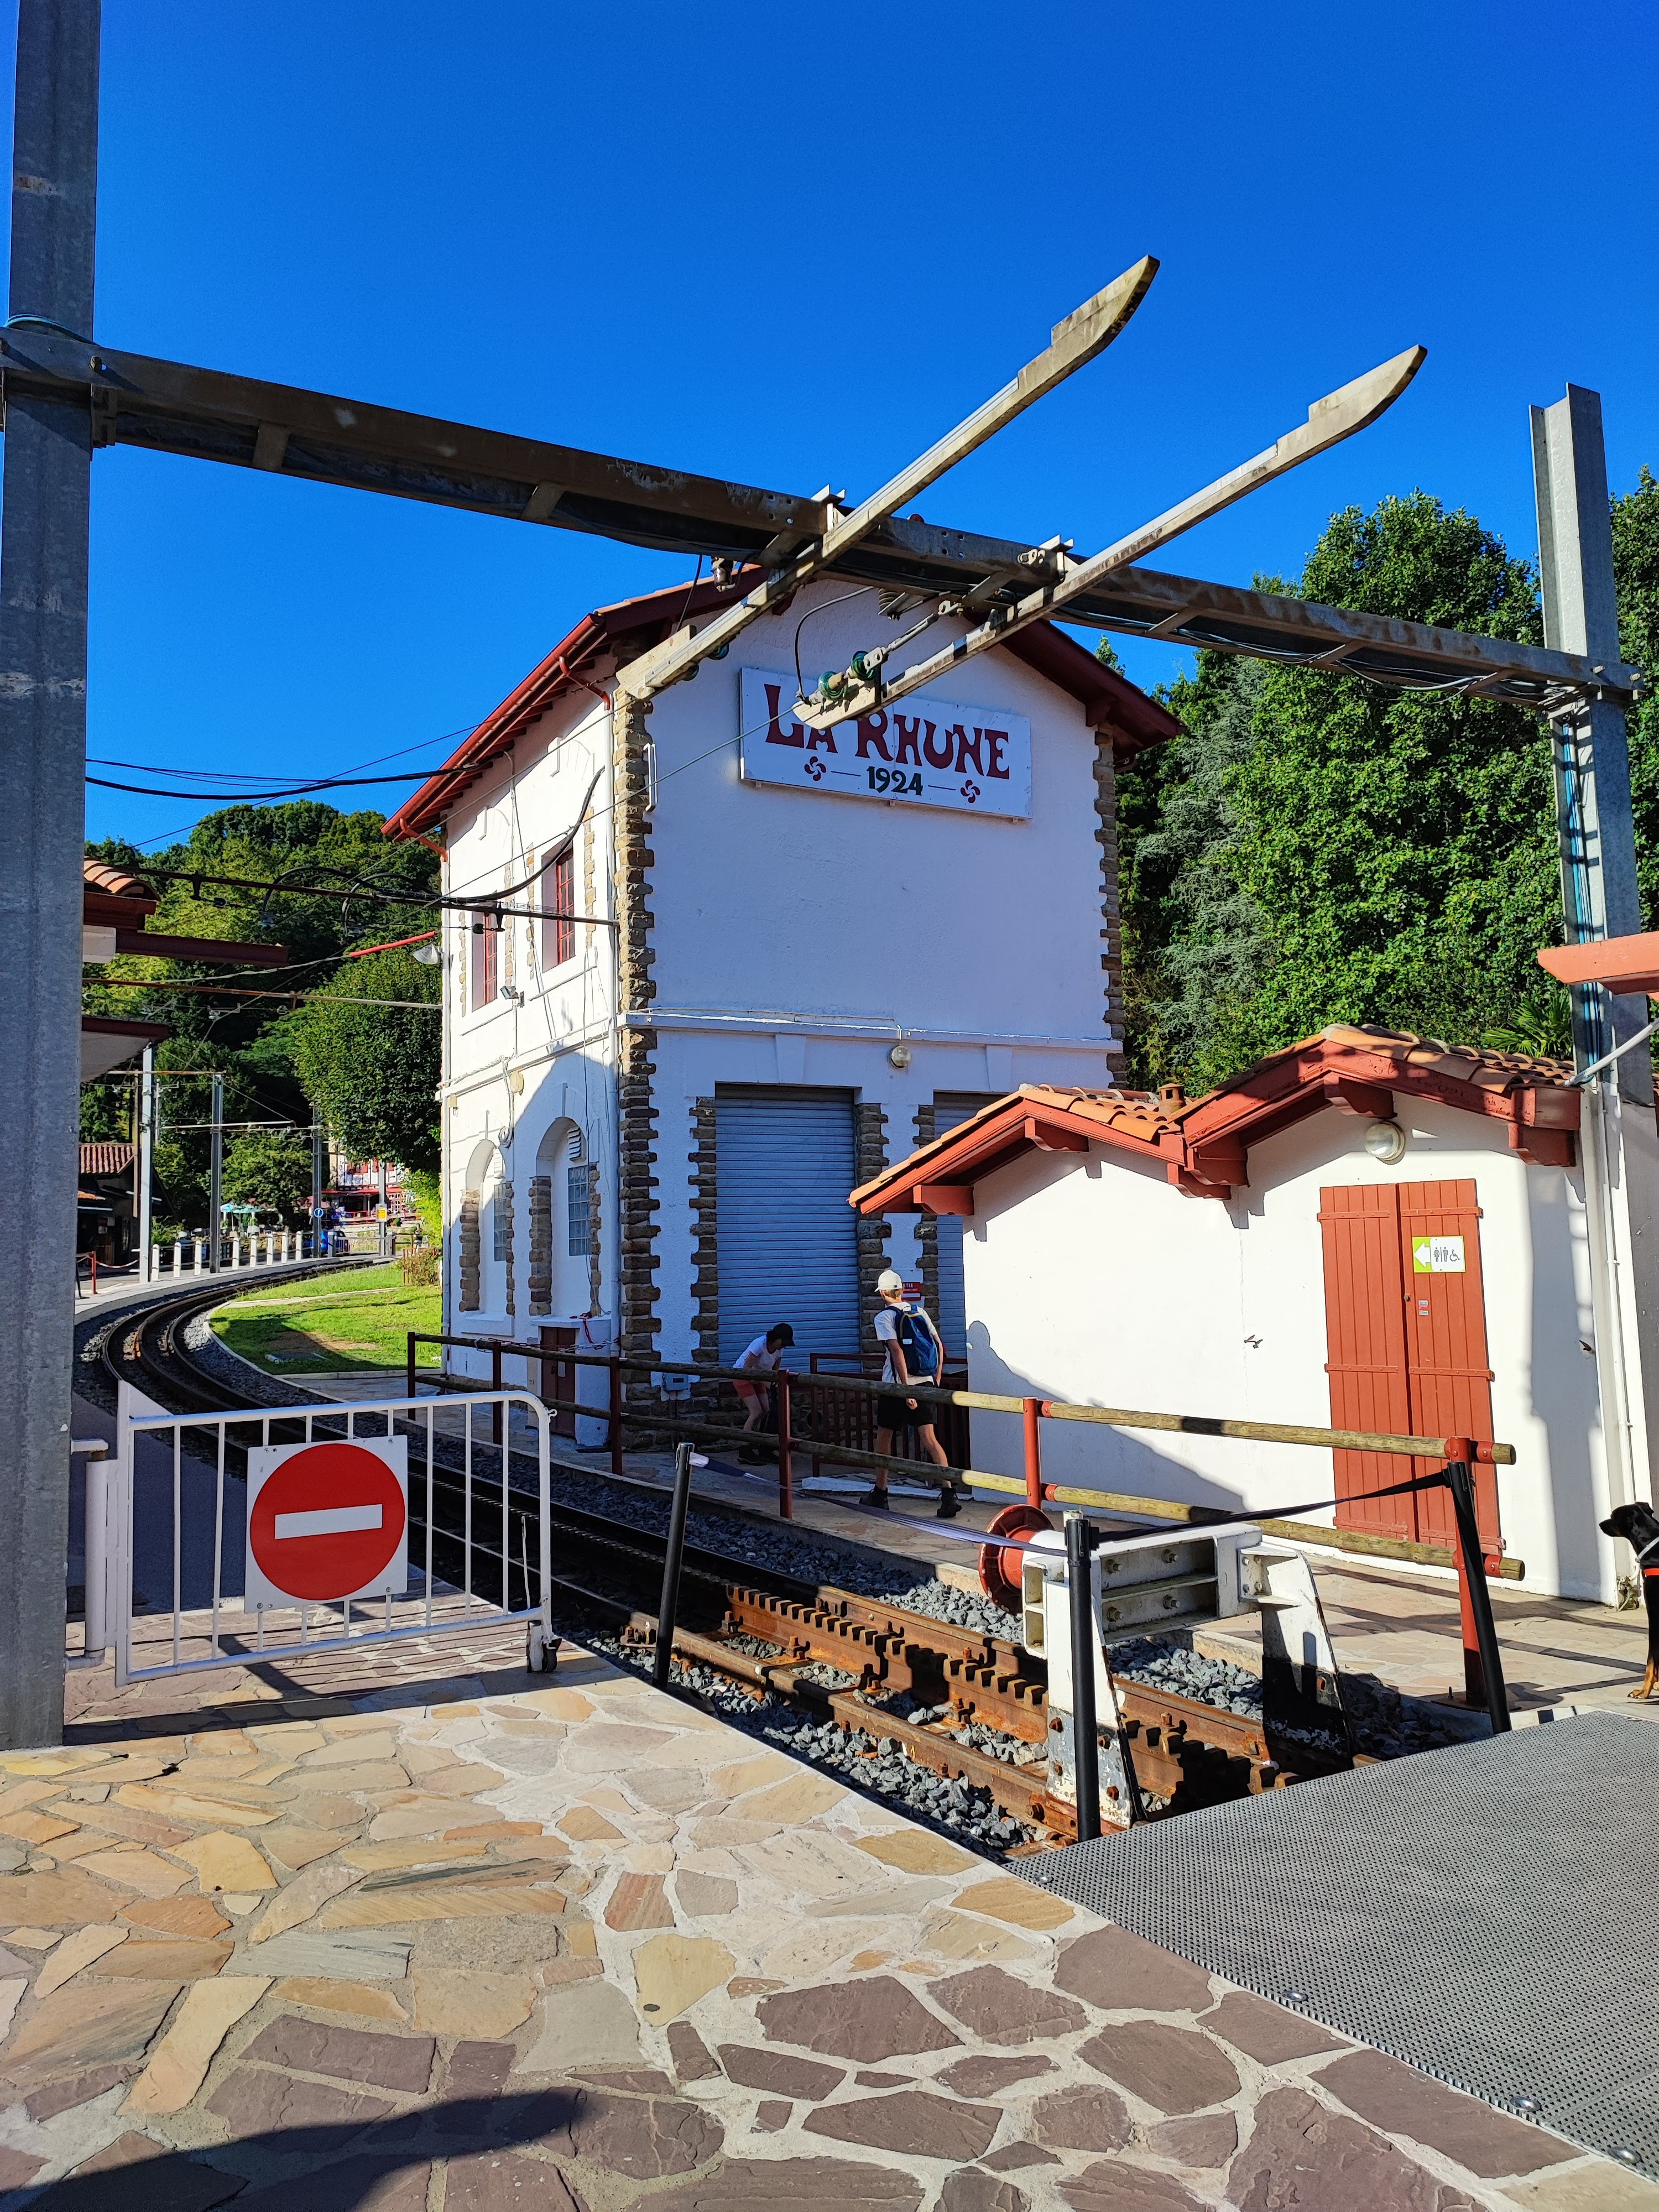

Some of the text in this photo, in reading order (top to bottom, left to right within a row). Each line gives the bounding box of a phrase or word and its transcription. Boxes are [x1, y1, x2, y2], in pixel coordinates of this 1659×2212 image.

[763, 683, 1010, 780] LA RHUNE
[866, 765, 924, 796] 1924
